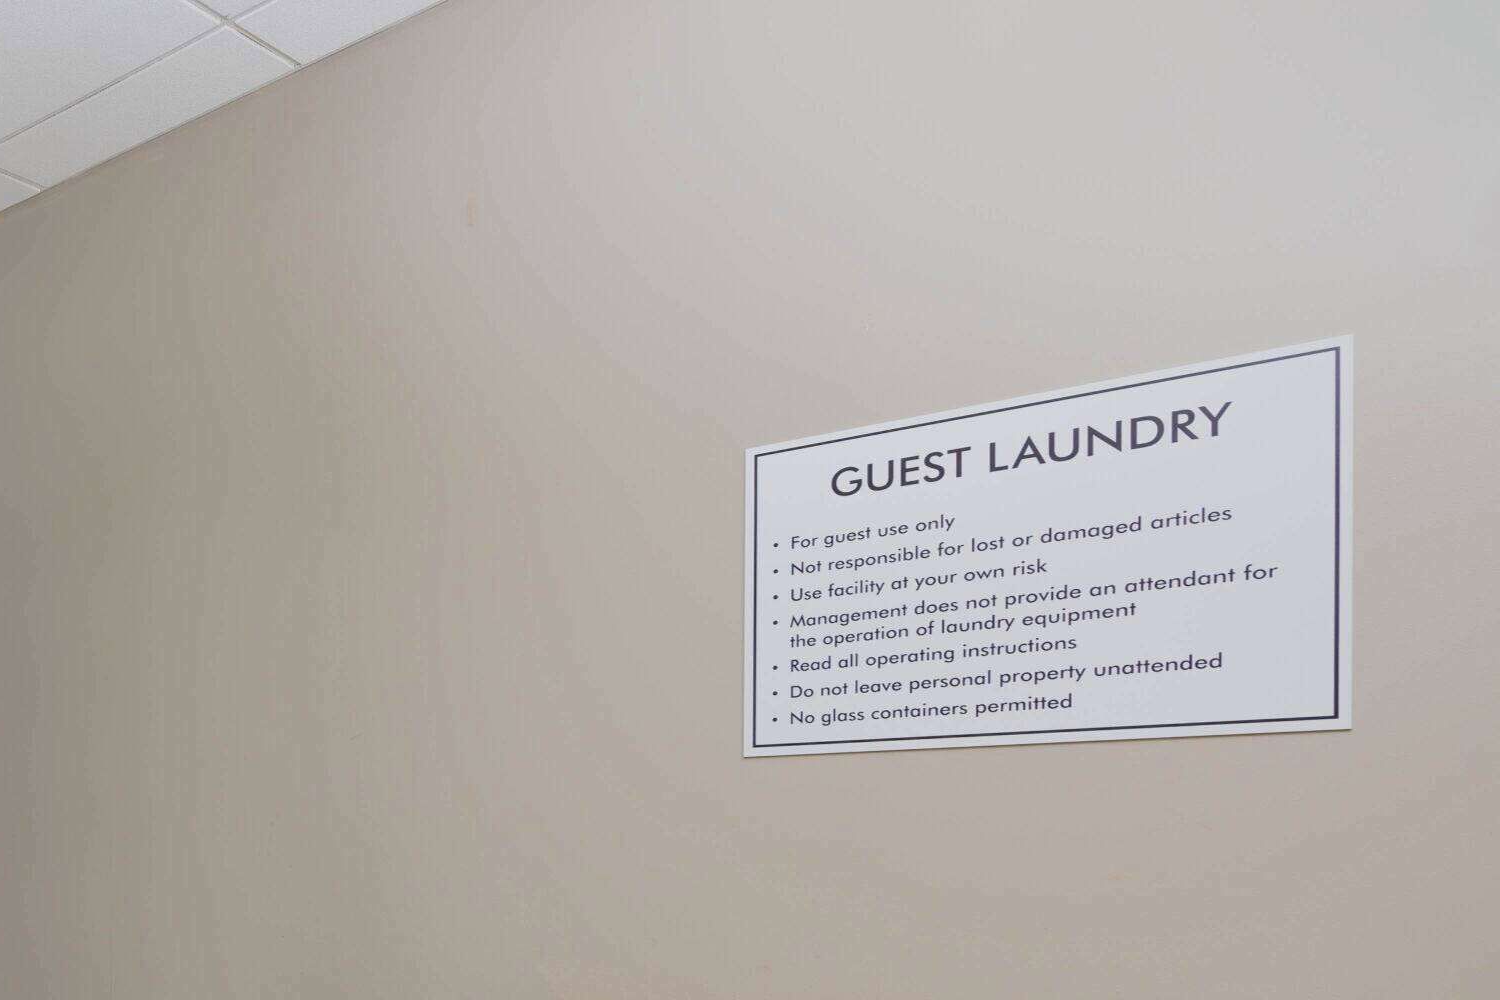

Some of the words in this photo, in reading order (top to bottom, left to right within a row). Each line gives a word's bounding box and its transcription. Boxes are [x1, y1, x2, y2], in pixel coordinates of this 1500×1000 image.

[831, 446, 972, 498] GUEST
[989, 400, 1233, 473] LAUNDRY
[791, 535, 818, 549] For
[824, 528, 871, 547] guest
[878, 523, 908, 538] use
[915, 514, 955, 532] only
[791, 560, 821, 575] Not
[829, 548, 930, 571] responsible
[938, 542, 964, 556] for
[971, 536, 1004, 552] lost
[1012, 535, 1033, 547] or
[1040, 516, 1142, 544] damaged
[1150, 507, 1232, 529] articles
[790, 605, 908, 628] Management
[915, 600, 958, 615] does
[967, 595, 997, 609] not
[1005, 585, 1081, 609] provide
[1090, 583, 1116, 596] an
[1125, 568, 1236, 594] attendant
[1244, 564, 1278, 581] for
[791, 588, 822, 601] Use
[828, 579, 884, 598] facility
[891, 577, 908, 590] at
[915, 573, 957, 590] your
[964, 568, 1004, 582] own
[1013, 559, 1047, 576] risk
[791, 636, 816, 647] the
[823, 625, 908, 647] operation
[916, 621, 934, 636] of
[942, 615, 1015, 634] laundry
[1022, 603, 1136, 628] equipment
[791, 657, 831, 672] Read
[838, 654, 858, 668] all
[866, 649, 954, 668] operating
[962, 637, 1077, 658] instructions
[791, 686, 814, 698] Do
[820, 684, 848, 696] not
[854, 680, 902, 694] leave
[909, 671, 991, 693] personal
[1000, 664, 1086, 687] property
[1094, 652, 1222, 677] unattended
[791, 712, 815, 724] No
[822, 709, 865, 726] glass
[871, 703, 967, 720] containers
[975, 693, 1072, 717] permitted
